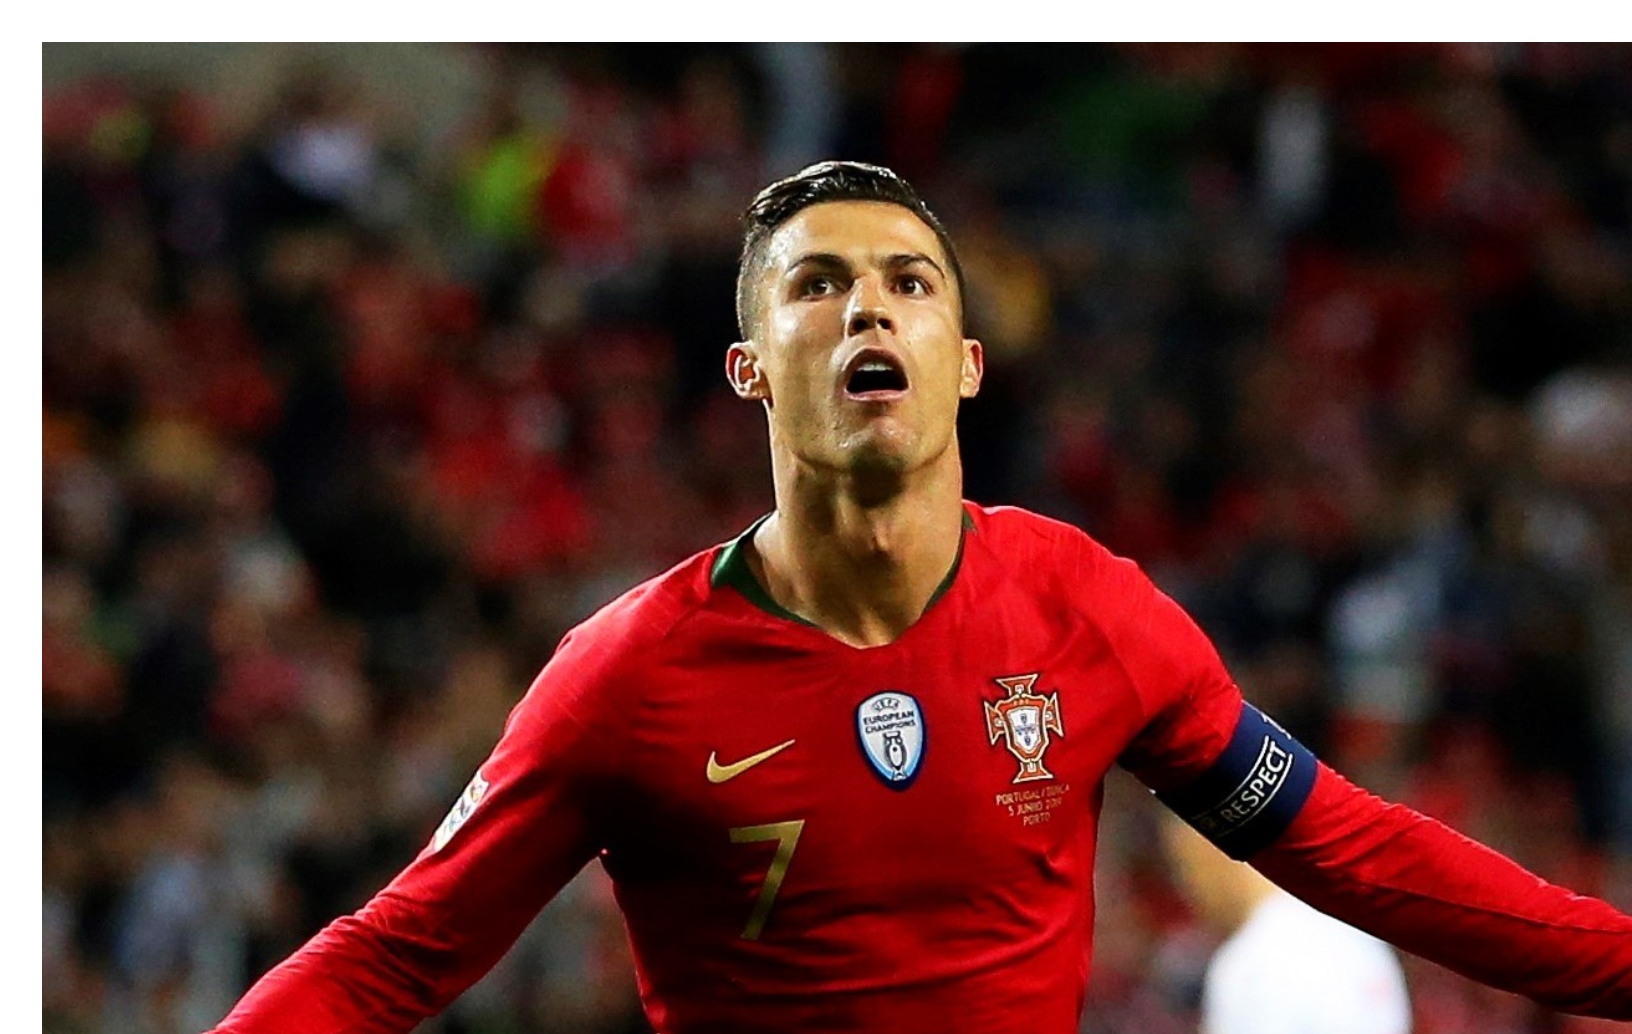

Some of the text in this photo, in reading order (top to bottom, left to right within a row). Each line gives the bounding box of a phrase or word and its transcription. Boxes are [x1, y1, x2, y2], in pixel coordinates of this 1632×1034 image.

[863, 710, 914, 725] EUROPEAN
[866, 719, 916, 734] CHAMPIONS
[1221, 741, 1287, 822] RESPECT
[729, 819, 805, 940] 7
